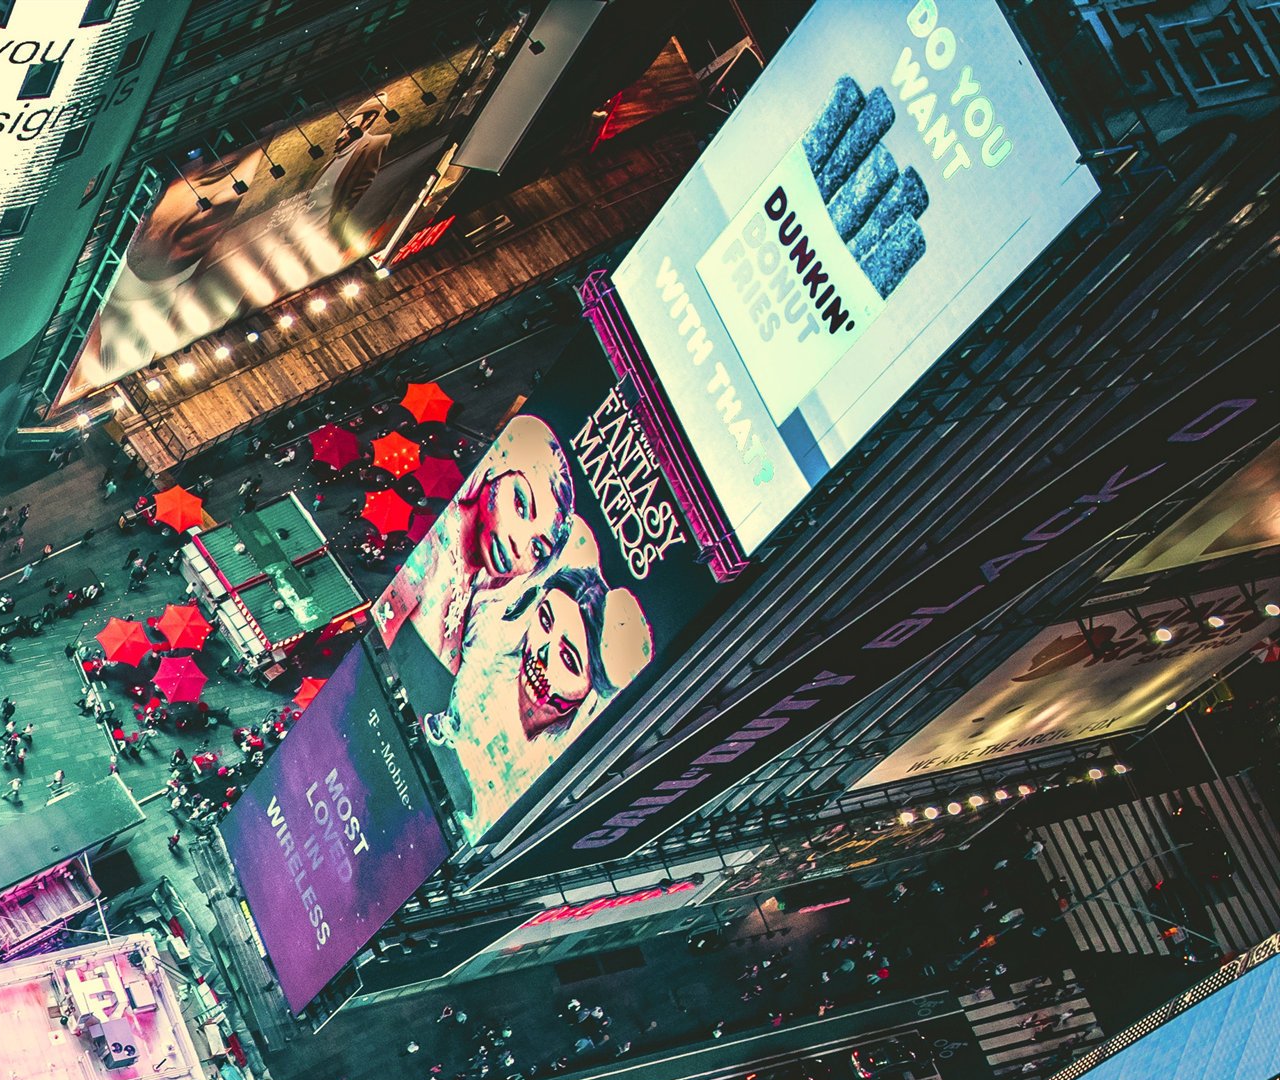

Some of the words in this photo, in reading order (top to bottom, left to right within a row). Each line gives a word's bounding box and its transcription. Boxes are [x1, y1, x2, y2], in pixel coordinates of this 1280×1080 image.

[890, 47, 972, 180] WANT
[907, 0, 957, 71] DO
[951, 65, 1013, 169] YOU
[655, 256, 714, 366] WITH
[721, 238, 782, 343] FRIES
[742, 212, 821, 343] DONUT
[764, 185, 856, 335] DUNKIN'
[593, 387, 686, 561] FANTASY
[572, 772, 713, 850] CALL
[690, 669, 857, 766] DUTY
[861, 462, 1167, 650] BLACK
[324, 767, 370, 856] MOST
[905, 757, 938, 775] WE
[937, 747, 983, 768] ARE
[980, 738, 1018, 757] THE
[265, 795, 332, 950] WIRELESS.
[303, 833, 325, 871] IN
[305, 781, 354, 884] LOVED
